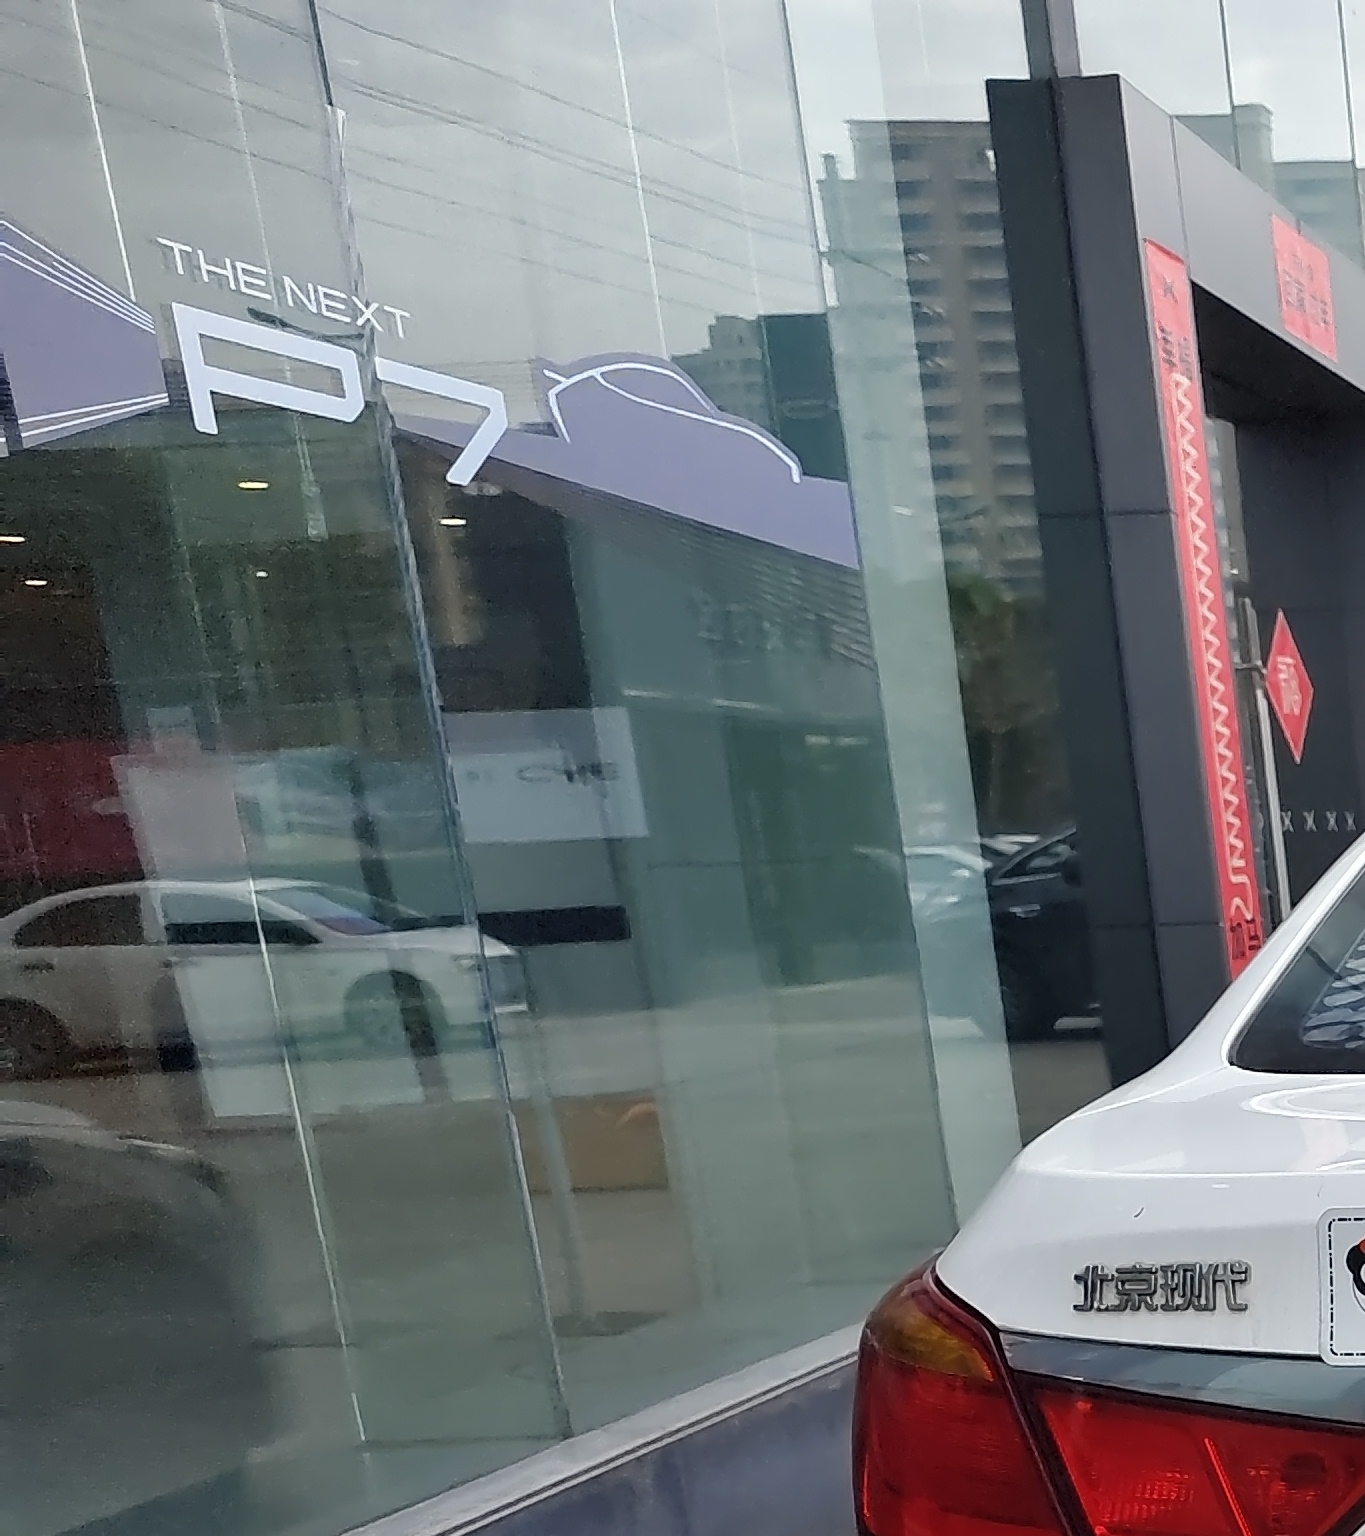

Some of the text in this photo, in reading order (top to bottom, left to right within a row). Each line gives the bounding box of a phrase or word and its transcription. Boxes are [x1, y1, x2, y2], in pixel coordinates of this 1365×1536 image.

[155, 236, 410, 338] THE NEXT
[172, 302, 508, 486] P7
[1073, 1261, 1250, 1312] 北京现代
